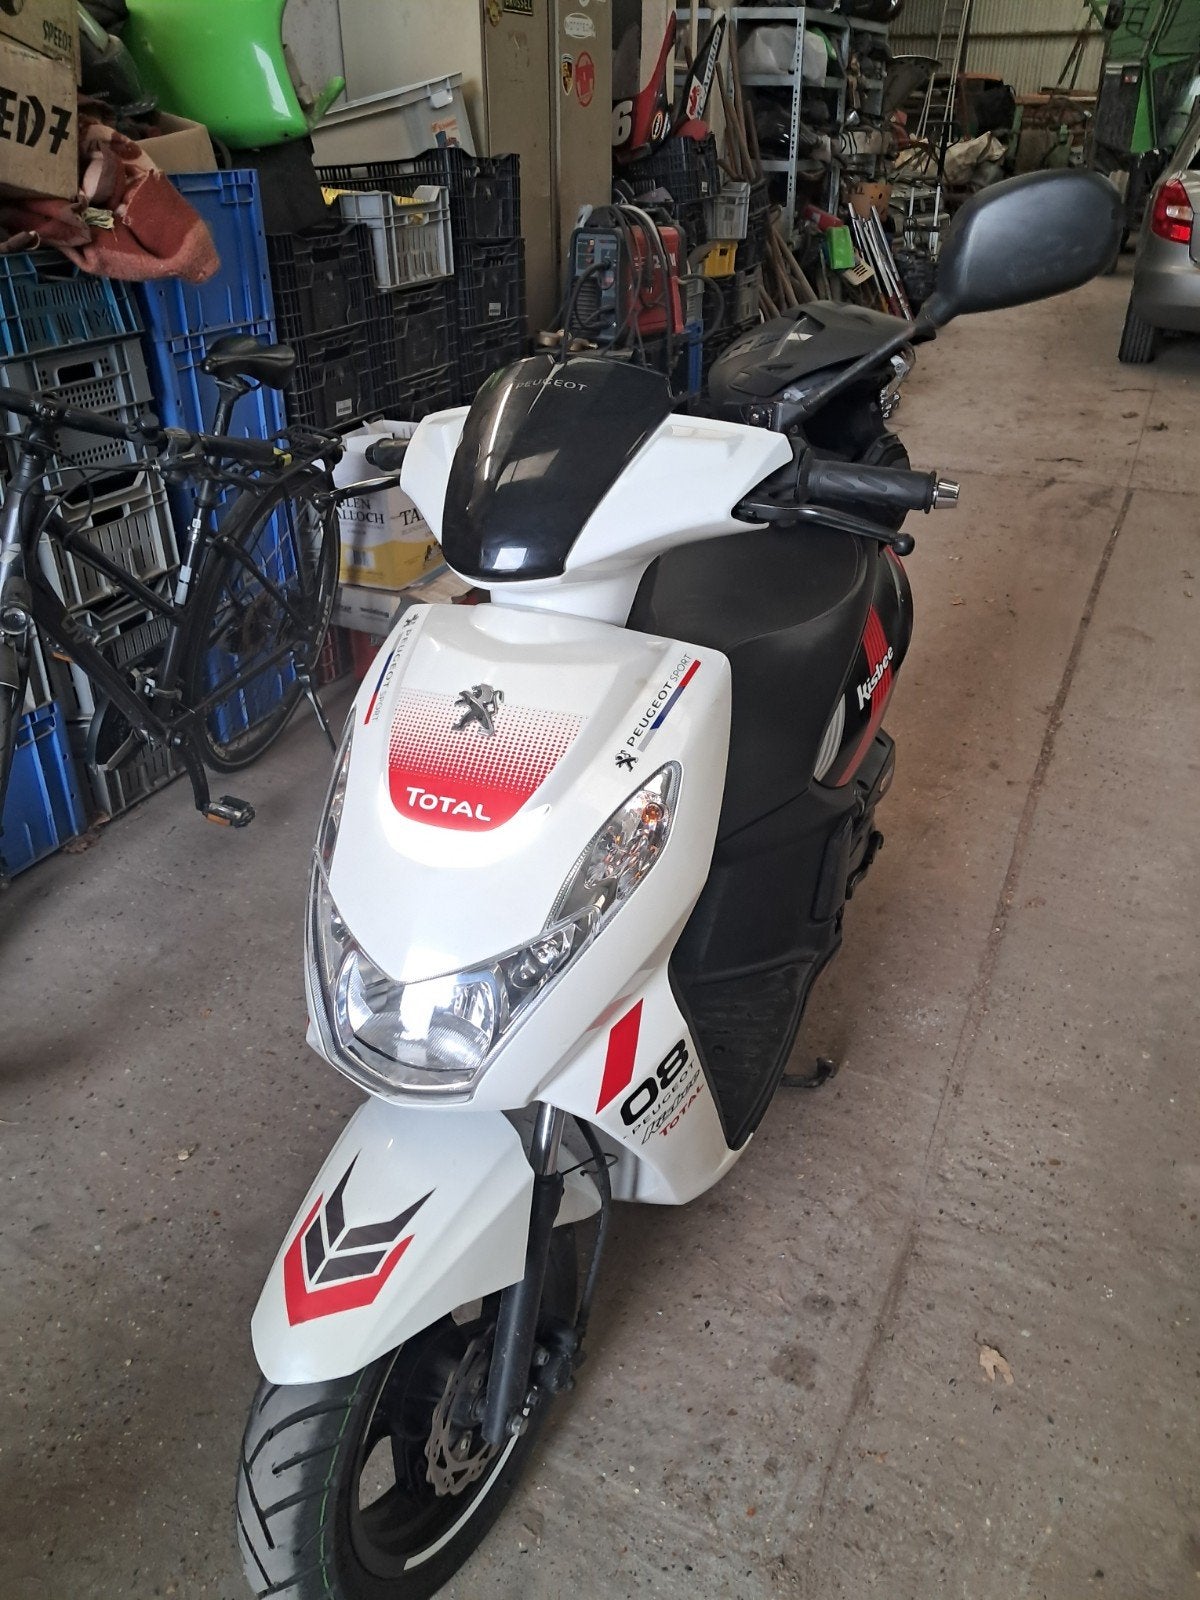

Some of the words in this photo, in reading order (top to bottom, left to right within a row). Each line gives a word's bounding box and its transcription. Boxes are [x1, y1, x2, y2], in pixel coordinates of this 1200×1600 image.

[42, 19, 73, 51] SPEED7
[515, 378, 588, 392] PEUGEOT
[399, 508, 425, 526] TA
[382, 628, 412, 688] PEUGEOT
[856, 646, 894, 711] Kisbee
[626, 681, 673, 747] PEUGEOT
[669, 653, 692, 682] SPORT
[620, 1038, 689, 1126] 08
[632, 1059, 695, 1135] PEUGEOT
[659, 1083, 704, 1136] TOTAL
